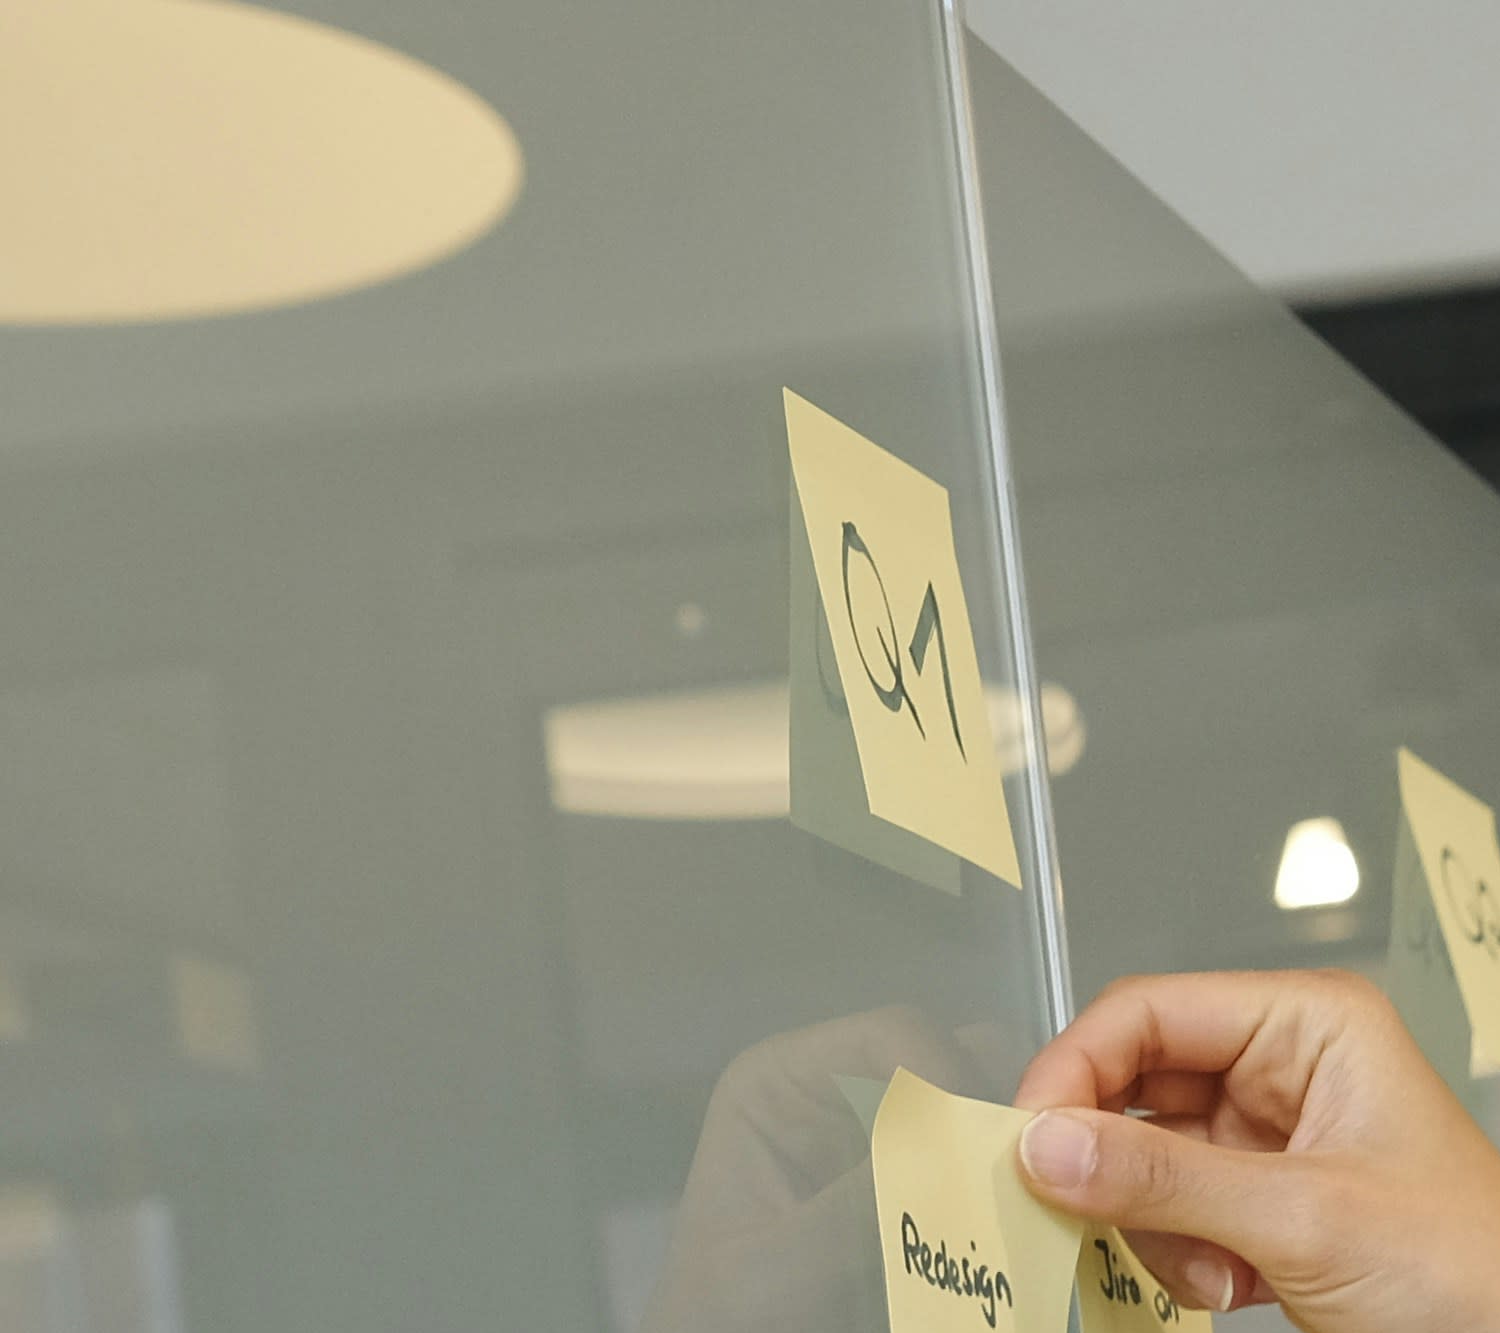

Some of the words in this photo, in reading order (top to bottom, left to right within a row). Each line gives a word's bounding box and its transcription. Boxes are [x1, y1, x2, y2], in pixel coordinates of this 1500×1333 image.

[842, 521, 967, 764] Q1
[901, 1211, 1013, 1329] Redesign
[1094, 1239, 1142, 1306] Jira
